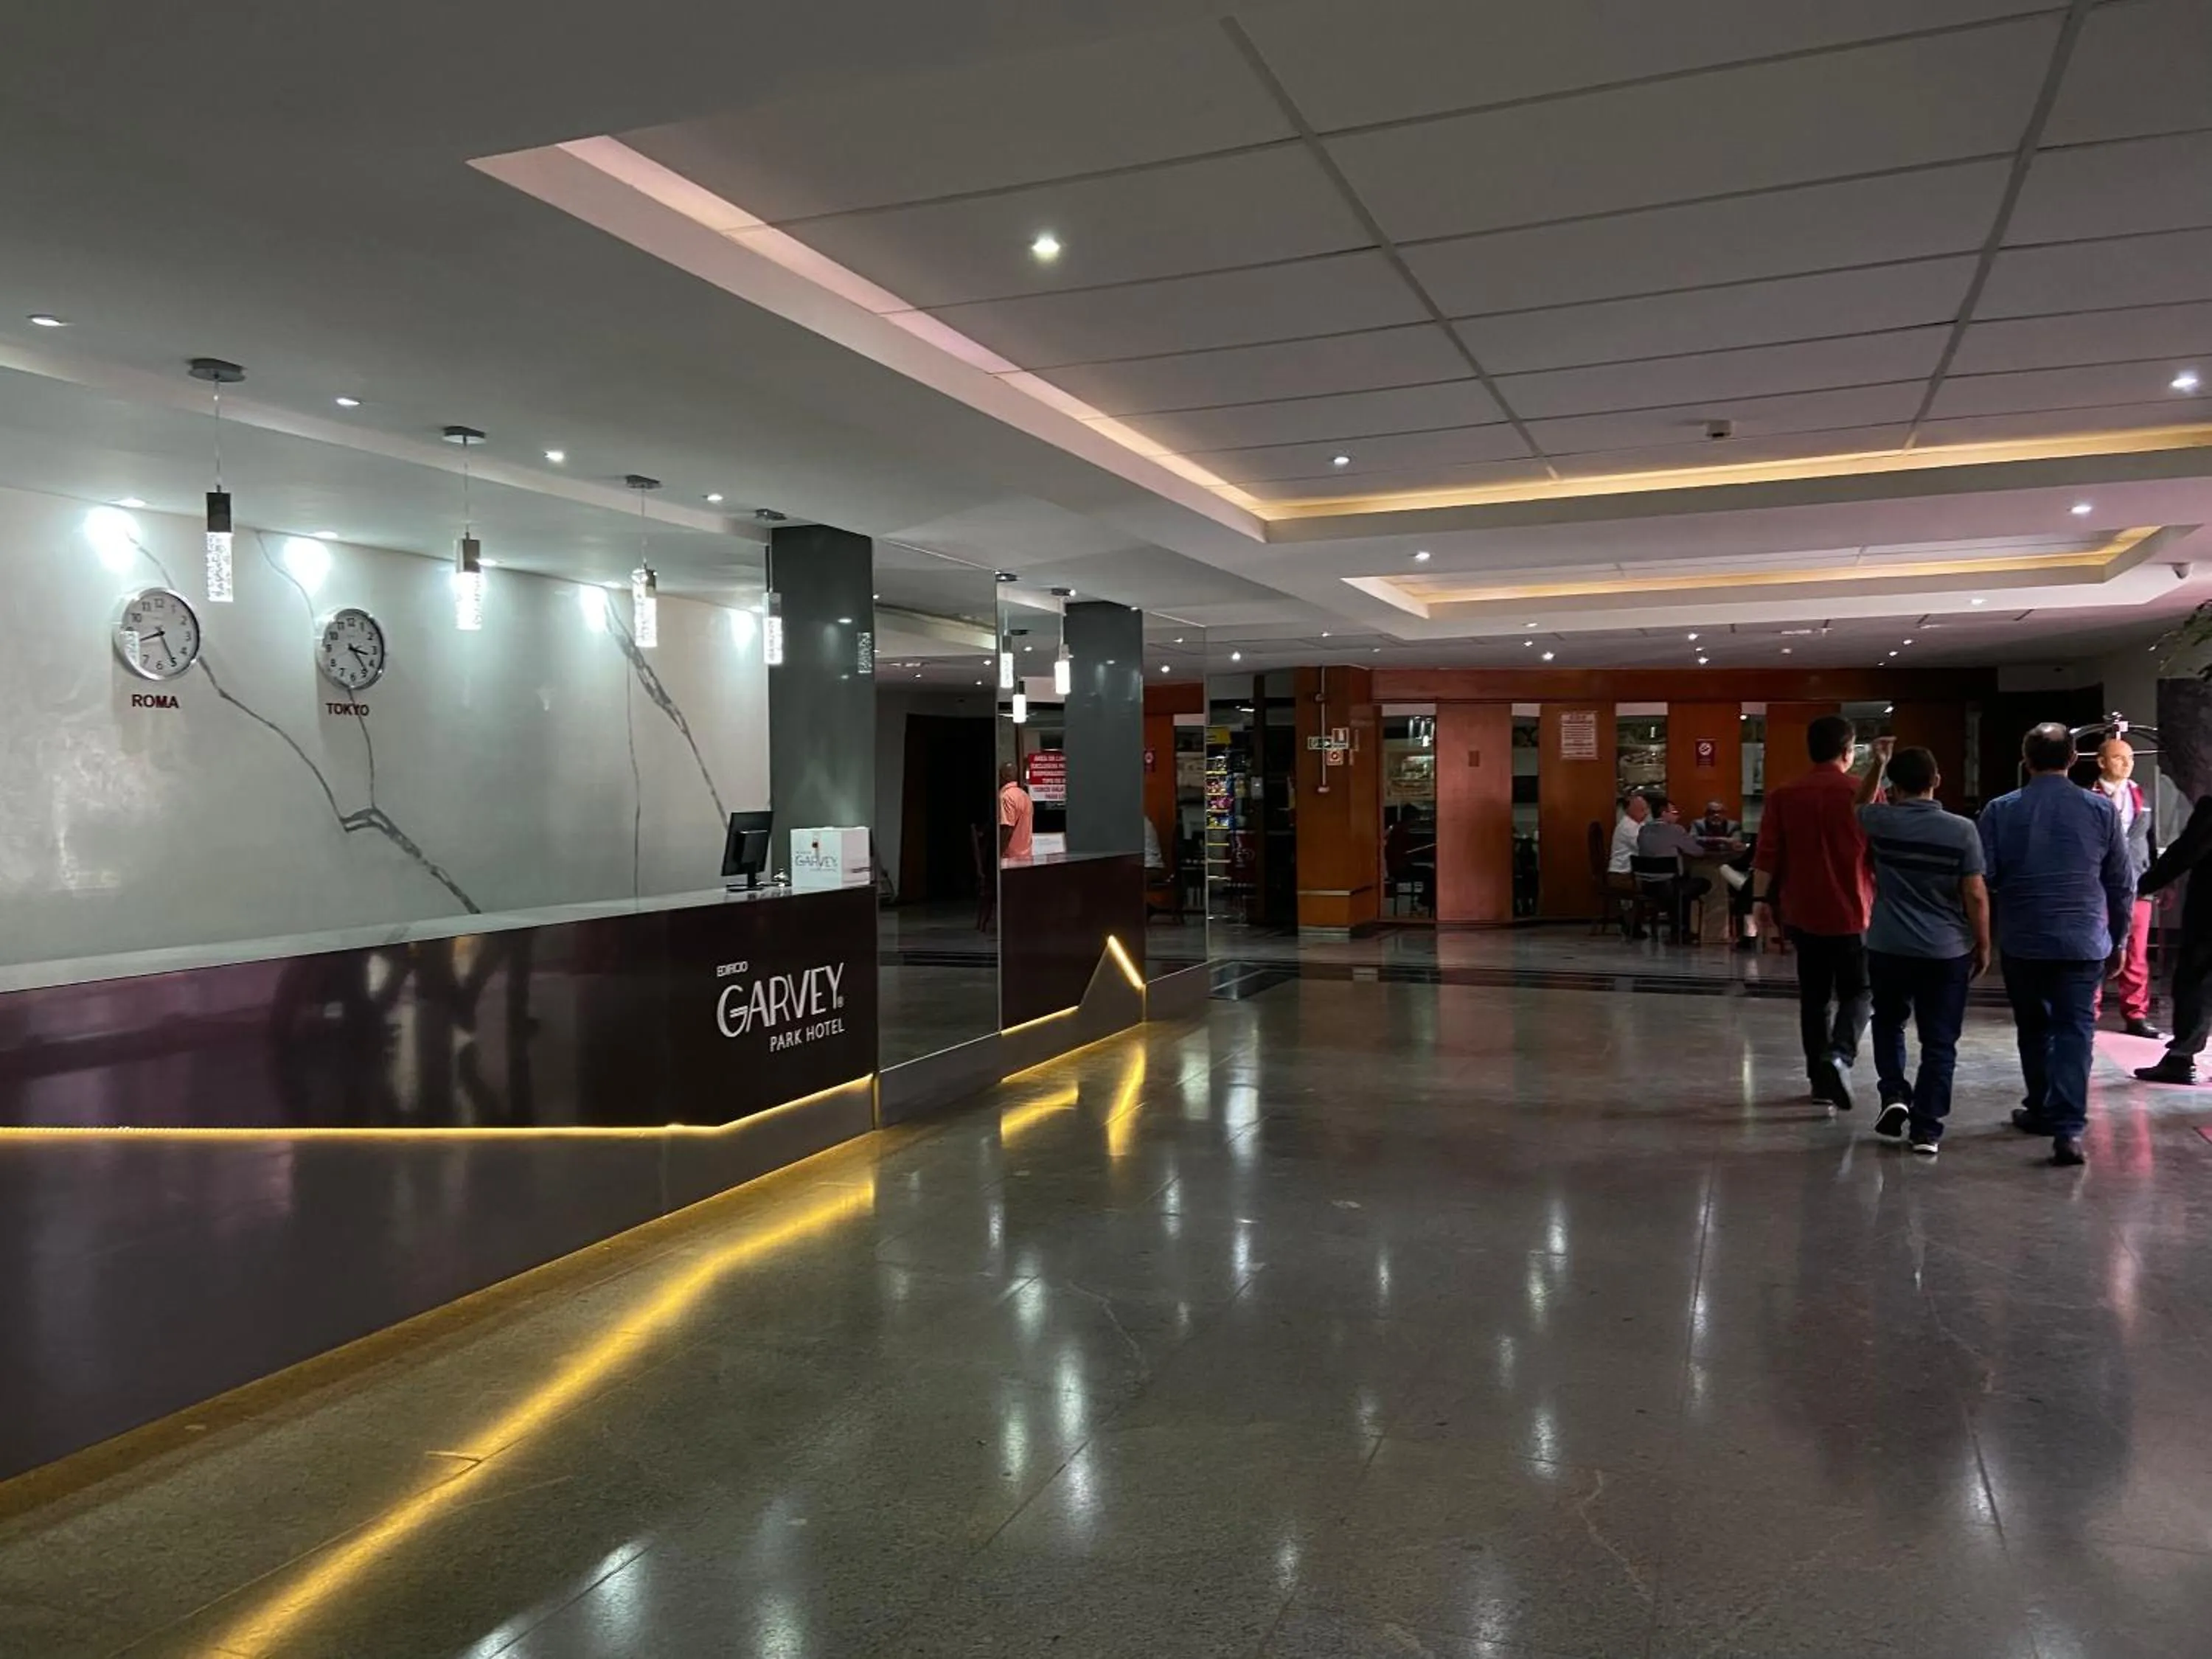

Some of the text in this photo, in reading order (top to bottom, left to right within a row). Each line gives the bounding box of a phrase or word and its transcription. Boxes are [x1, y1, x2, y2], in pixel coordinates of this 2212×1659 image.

[154, 598, 164, 608] 12
[132, 613, 142, 623] 10
[180, 615, 187, 626] 2
[131, 694, 180, 709] ROMA
[325, 703, 370, 716] TOKYO
[795, 855, 838, 868] GARVEY
[716, 961, 844, 1038] GARVEY
[770, 1018, 845, 1052] PARK HOTEL
